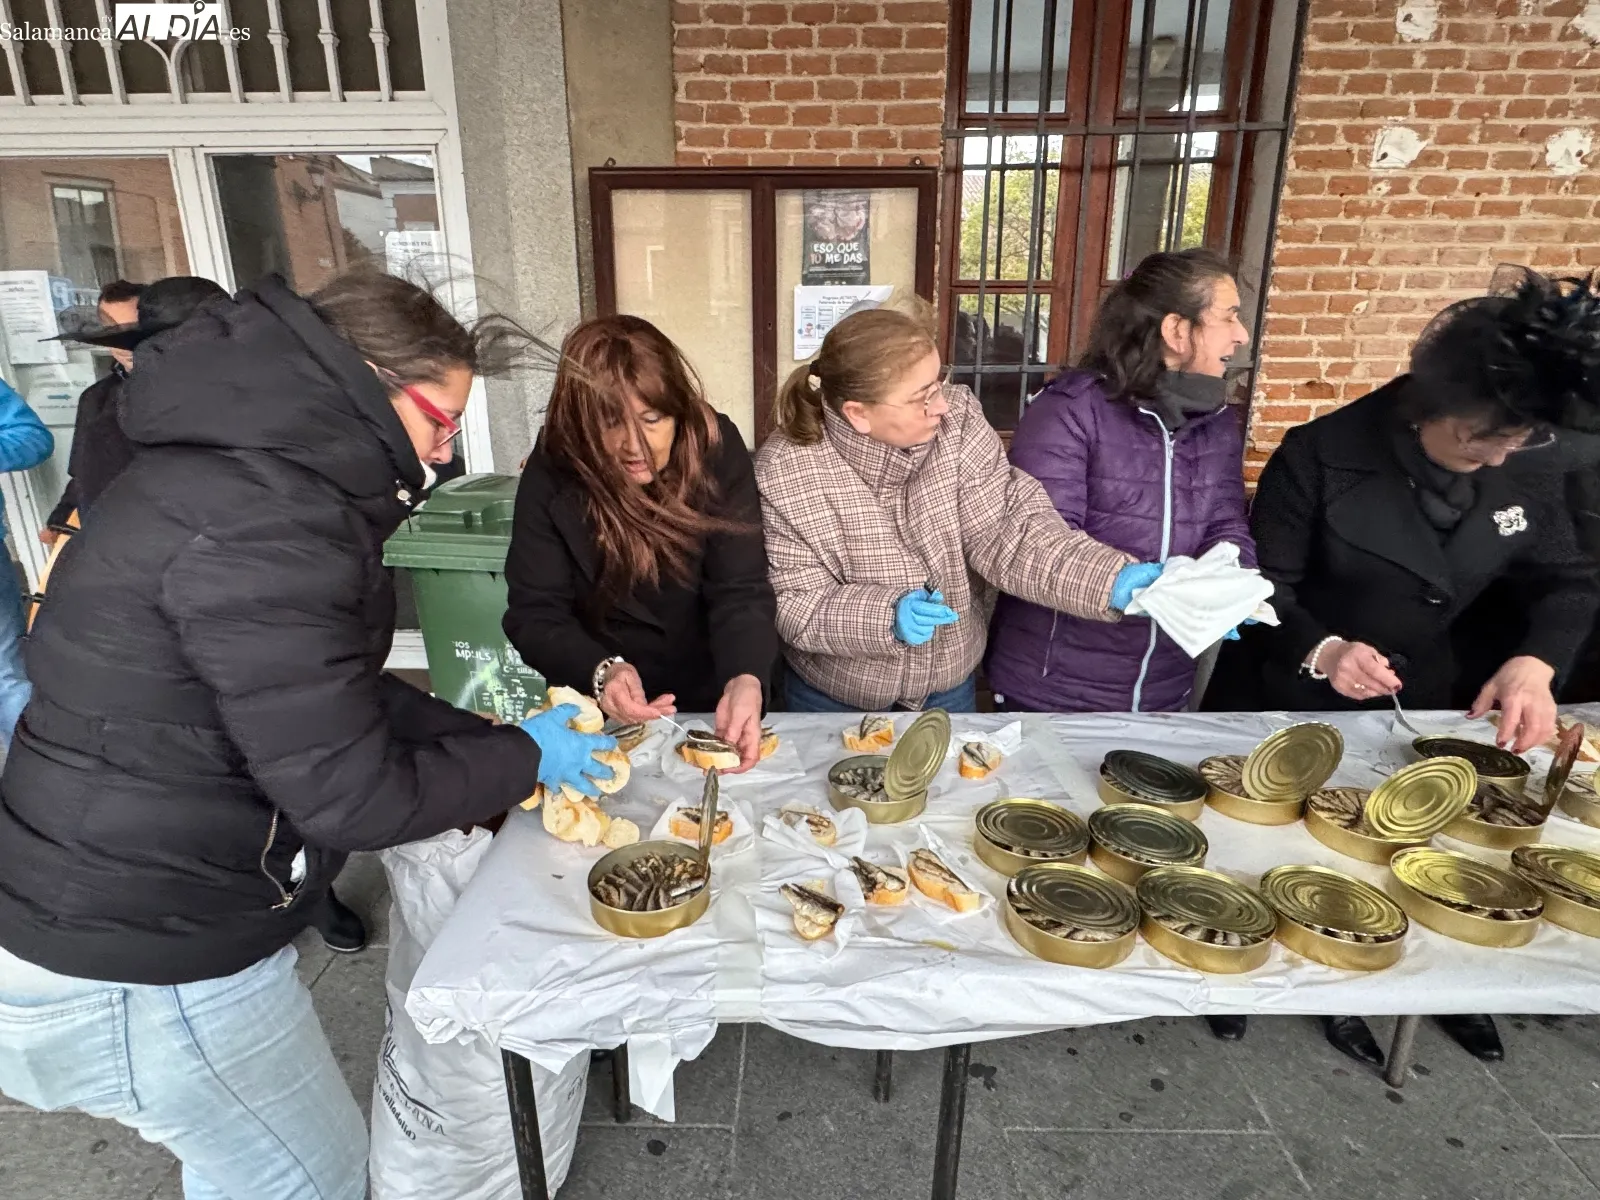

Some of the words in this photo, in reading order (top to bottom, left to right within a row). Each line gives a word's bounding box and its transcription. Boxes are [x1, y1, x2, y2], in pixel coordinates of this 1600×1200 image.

[813, 242, 834, 254] ESO
[836, 242, 859, 254] QUE
[824, 253, 841, 264] ME
[843, 252, 863, 265] DAS
